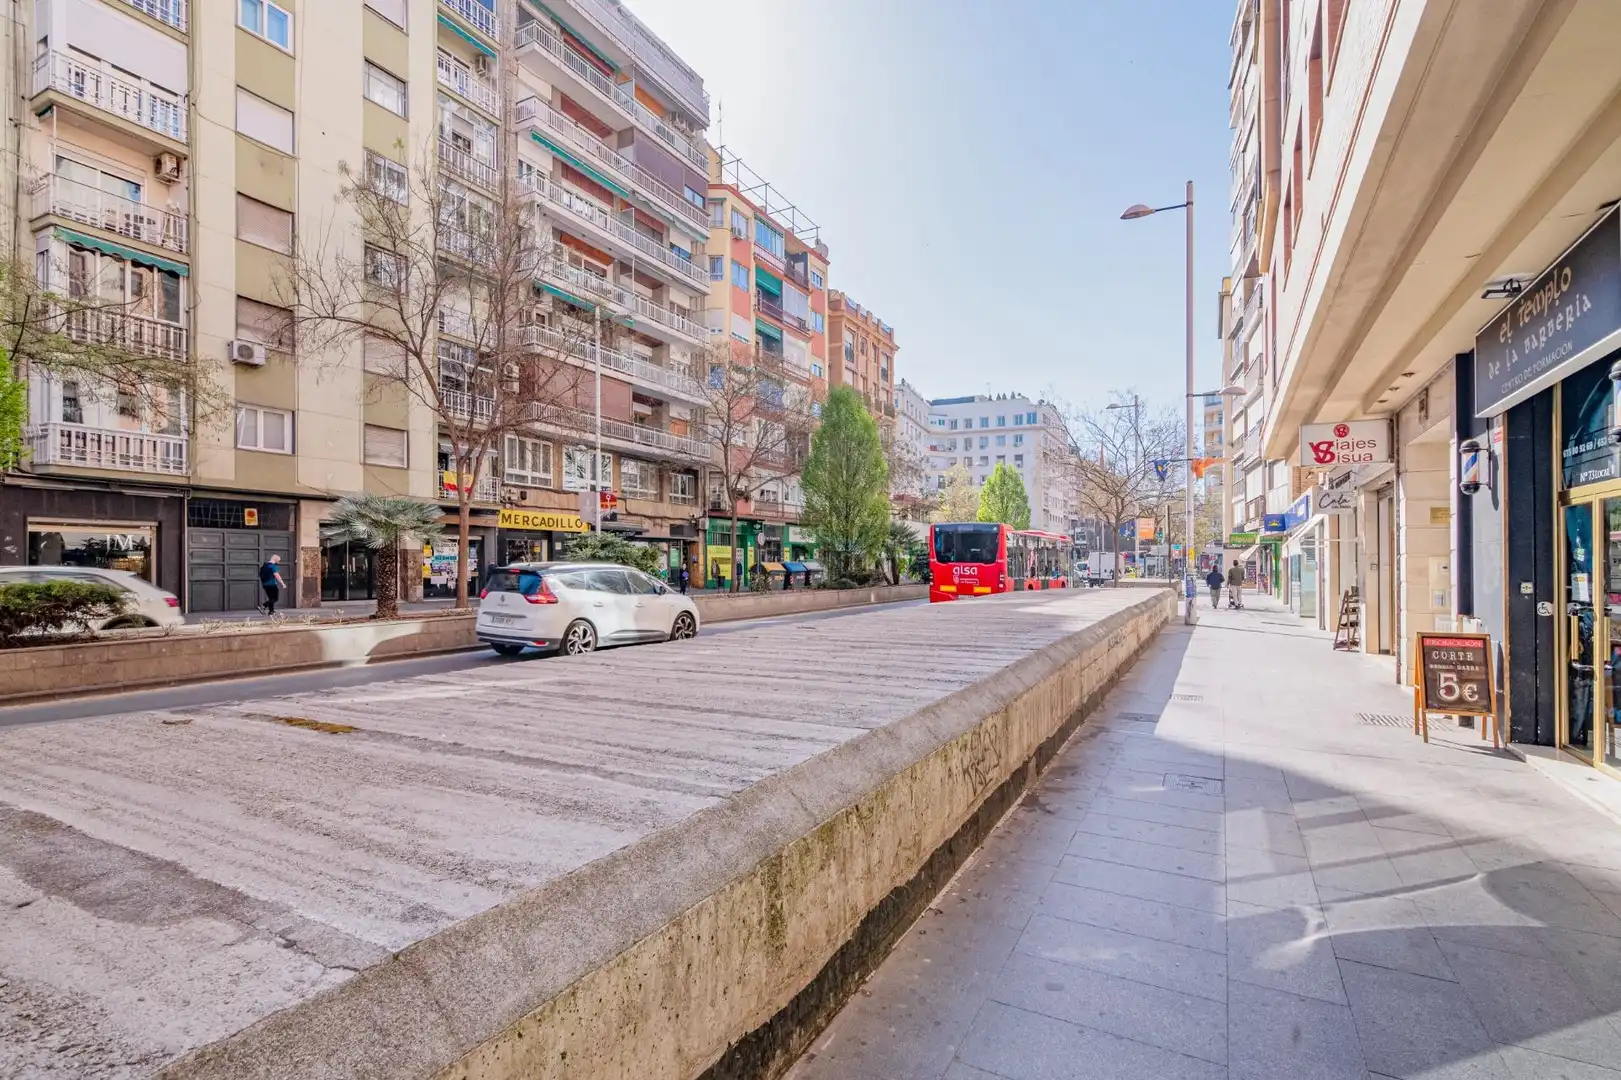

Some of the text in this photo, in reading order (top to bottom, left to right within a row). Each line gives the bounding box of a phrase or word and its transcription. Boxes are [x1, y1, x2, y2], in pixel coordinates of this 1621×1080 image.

[1518, 266, 1572, 327] templo
[501, 512, 583, 529] MERCADILLO
[952, 565, 978, 576] alsa
[1432, 650, 1474, 662] CORTE
